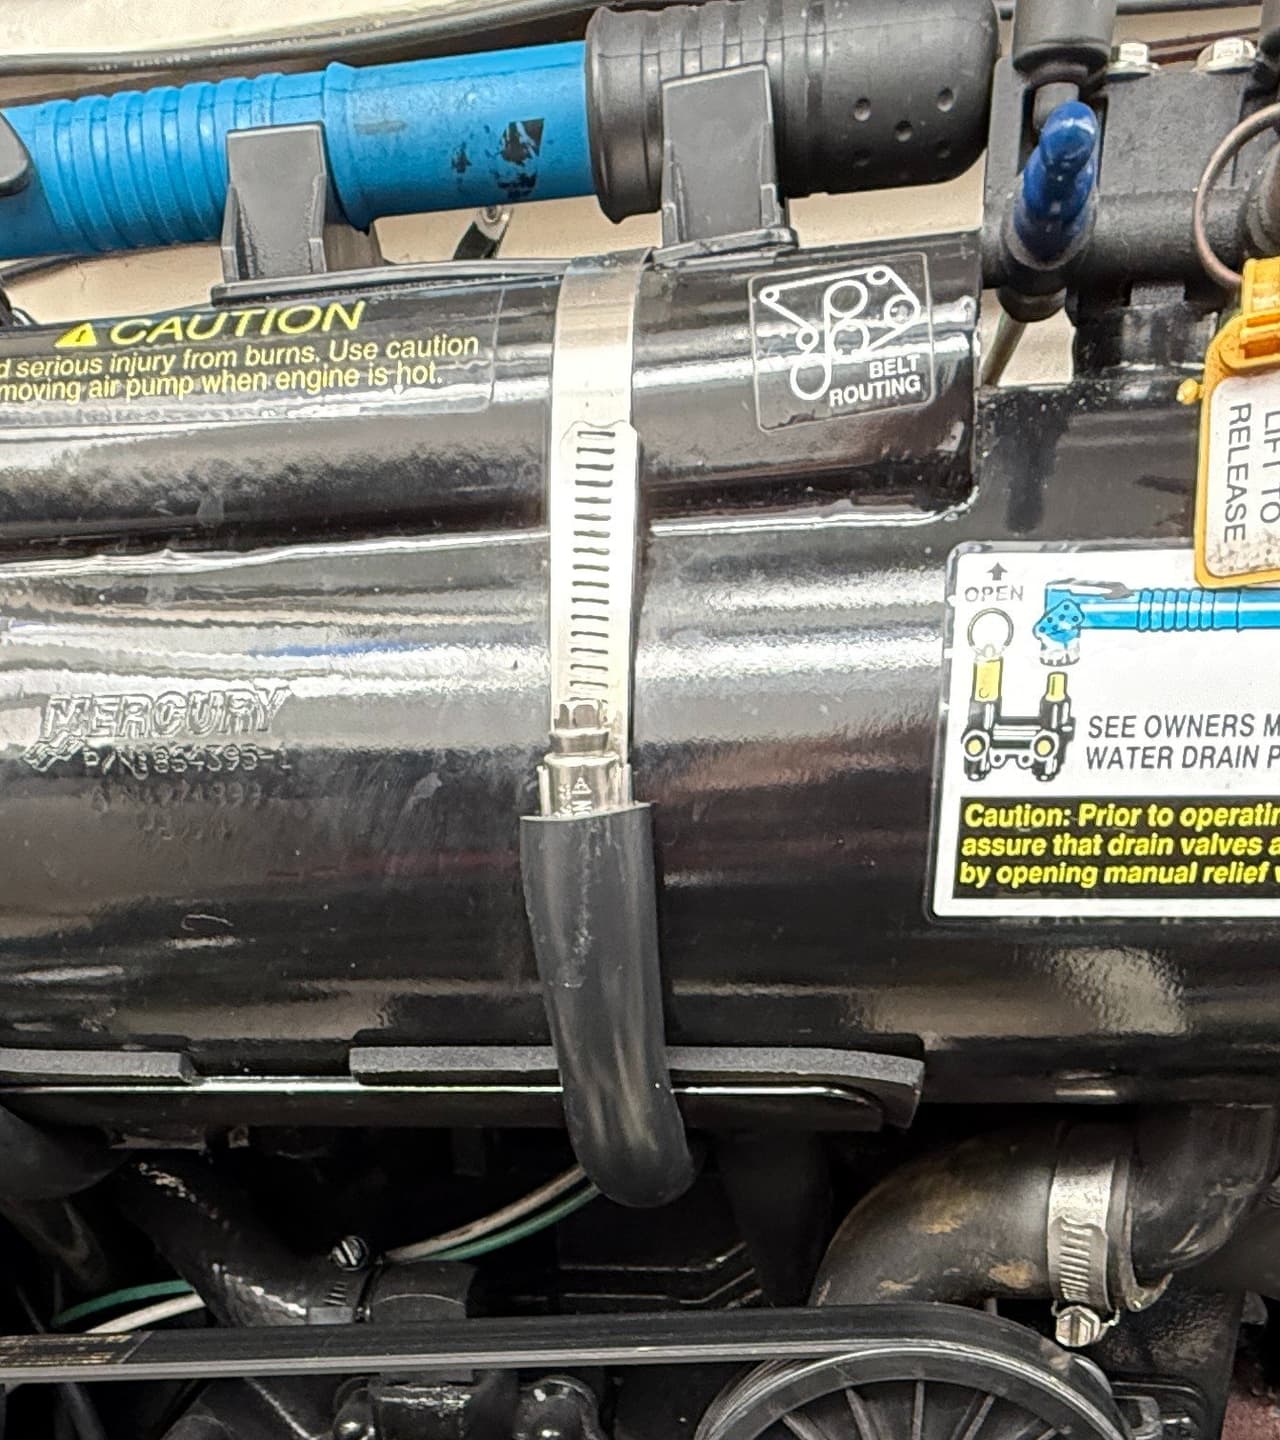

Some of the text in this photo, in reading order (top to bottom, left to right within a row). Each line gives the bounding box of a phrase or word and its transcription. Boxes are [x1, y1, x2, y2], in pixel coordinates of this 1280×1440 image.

[110, 300, 367, 345] CAUTION
[16, 355, 103, 378] serious
[110, 351, 176, 376] injury
[182, 345, 237, 370] from
[245, 345, 320, 367] burns.
[329, 338, 378, 362] Use
[386, 333, 480, 360] caution
[869, 354, 920, 380] BELT
[88, 374, 124, 398] air
[126, 374, 195, 404] pump
[201, 369, 268, 394] when
[275, 364, 360, 396] engine
[367, 361, 389, 386] is
[396, 360, 443, 386] hot.
[829, 374, 921, 408] ROUTING
[1223, 402, 1252, 544] RELEASE
[964, 584, 1025, 604] OPEN
[45, 687, 294, 740] MERCURY
[1087, 714, 1139, 740] SEE
[1143, 713, 1256, 739] OWNERS
[1084, 745, 1177, 771] WATER
[1181, 744, 1260, 770] DRAIN
[964, 802, 1072, 829] Caution:
[1078, 802, 1143, 828] Prior
[1147, 803, 1174, 827] to
[960, 835, 1048, 857] assure
[1052, 832, 1104, 857] that
[1107, 832, 1174, 857] drain
[1180, 832, 1263, 856] valves
[959, 861, 991, 889] by
[995, 861, 1099, 889] opening
[1103, 861, 1198, 885] manual
[1202, 861, 1271, 884] relief
